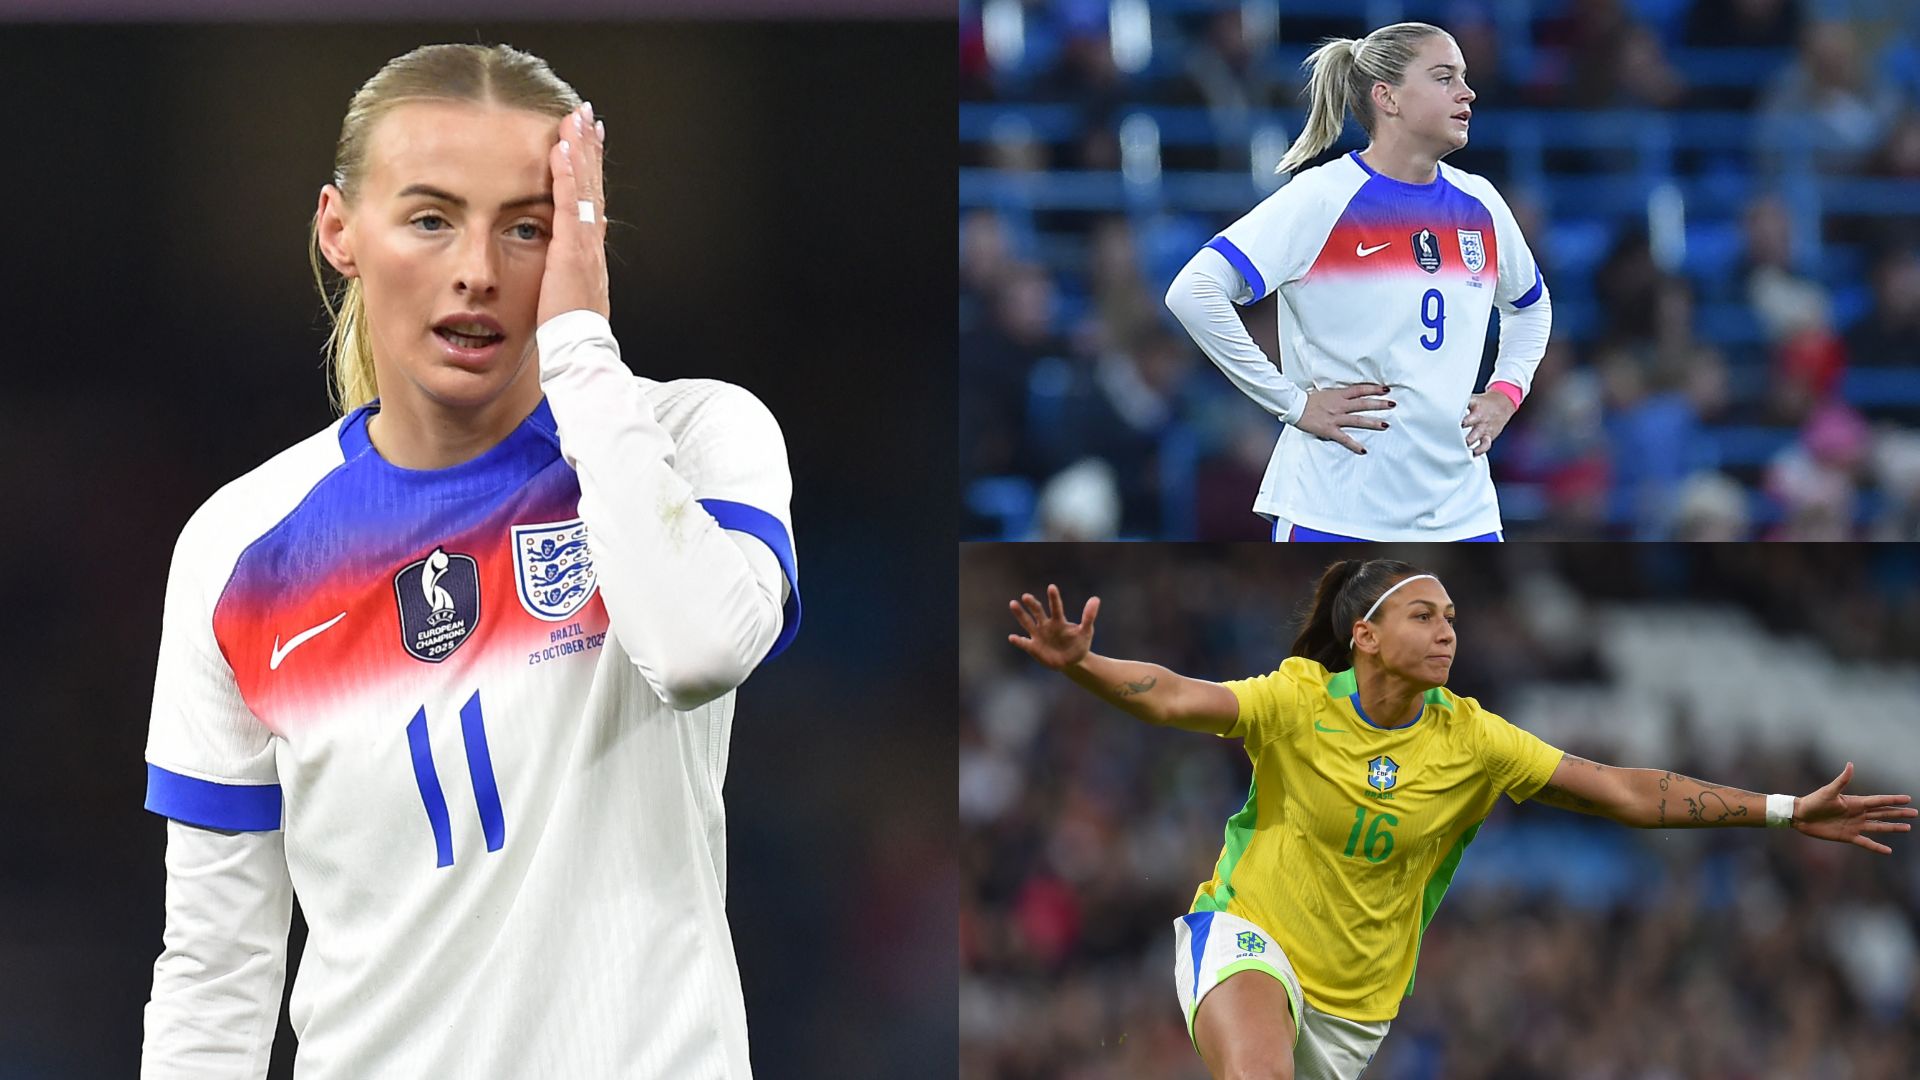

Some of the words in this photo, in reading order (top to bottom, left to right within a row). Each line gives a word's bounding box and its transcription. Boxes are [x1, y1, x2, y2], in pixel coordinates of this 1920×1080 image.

[1420, 288, 1444, 351] 9
[417, 619, 465, 640] EUROPEAN
[428, 611, 454, 625] UEFA
[416, 627, 466, 650] CHAMPIONS
[550, 622, 583, 643] BRAZIL
[428, 640, 455, 656] 2025
[528, 651, 541, 665] 25
[542, 638, 585, 661] OCTOBER
[406, 688, 506, 868] 11
[1343, 806, 1398, 864] 16
